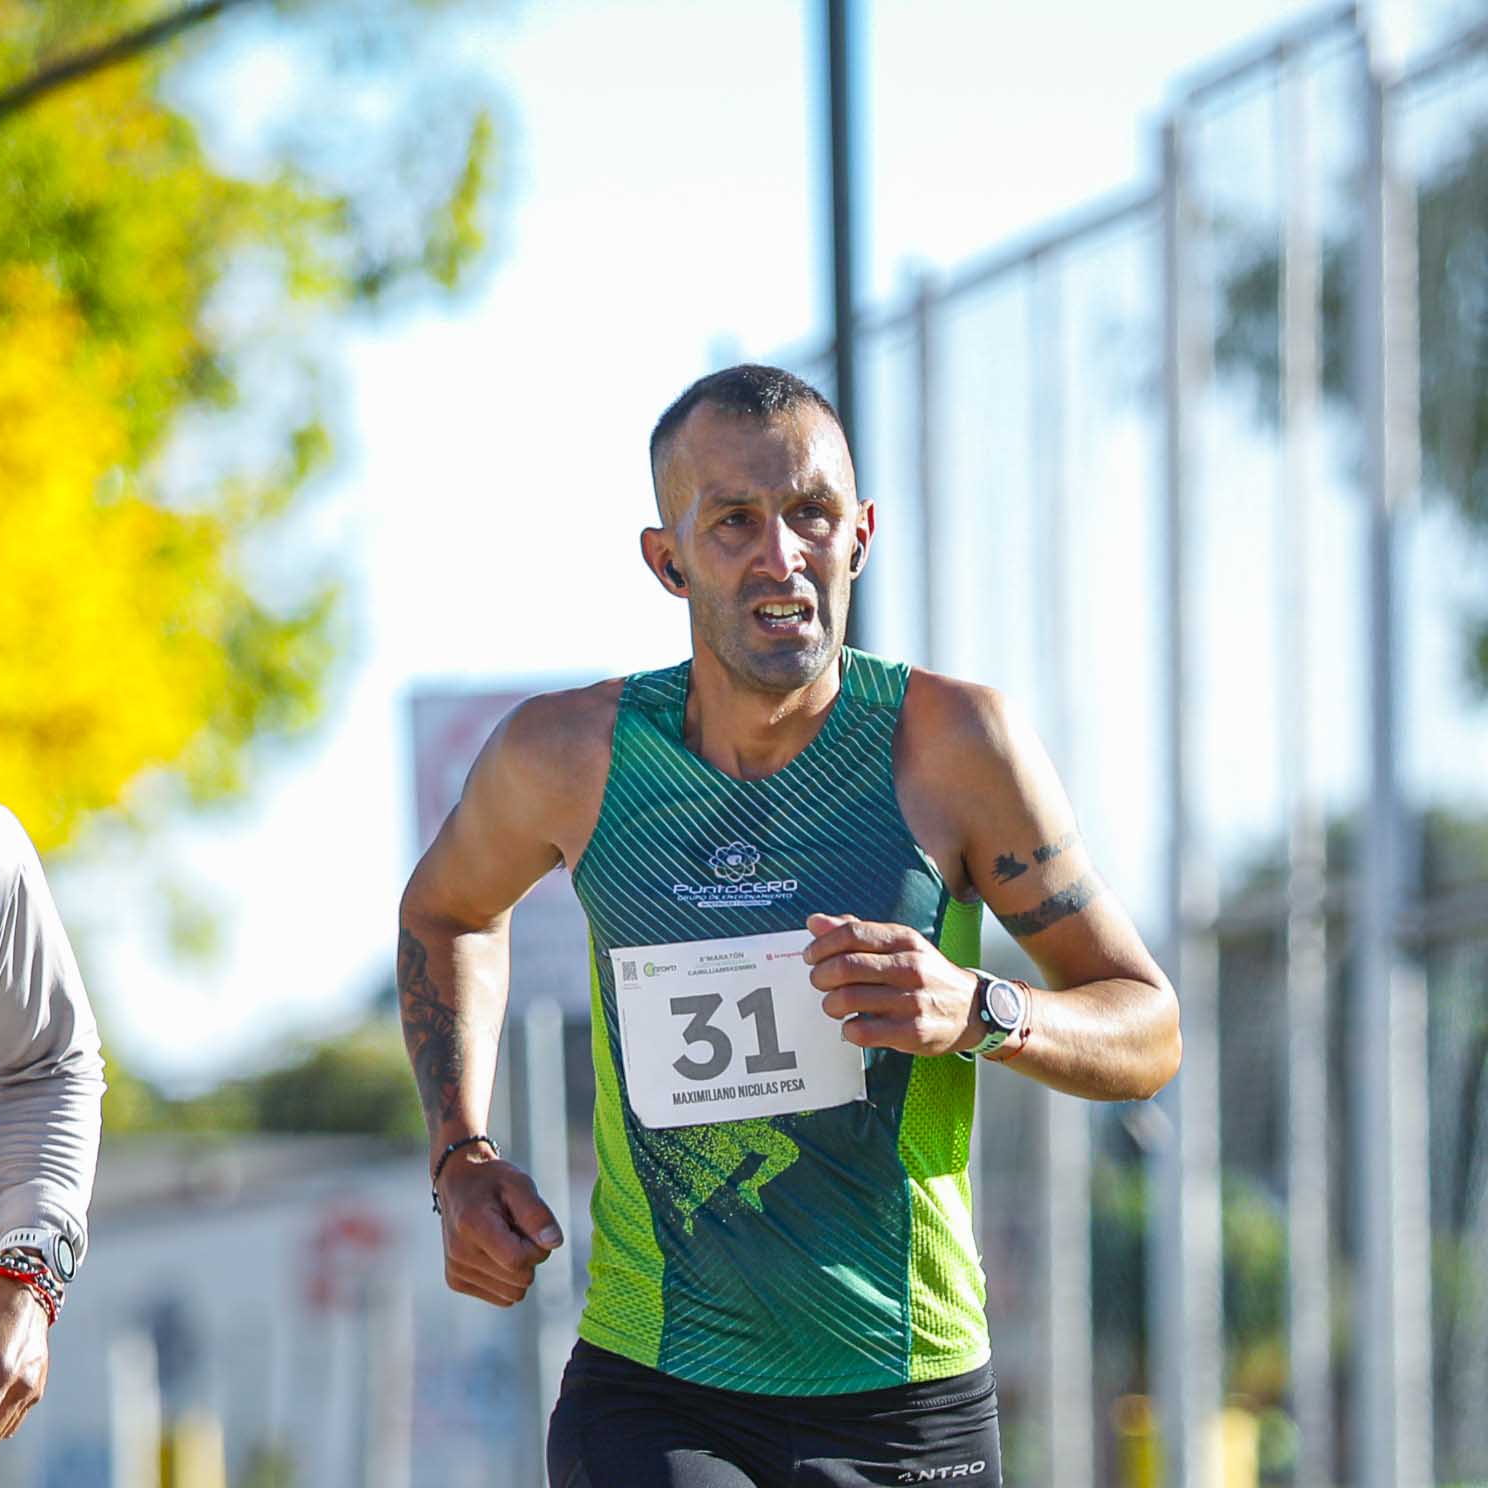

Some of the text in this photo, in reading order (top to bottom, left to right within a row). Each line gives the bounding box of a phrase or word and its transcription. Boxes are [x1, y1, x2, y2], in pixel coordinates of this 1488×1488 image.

[669, 986, 798, 1082] 31
[672, 1077, 806, 1105] MAXIMILIANO NICOLAS PESA
